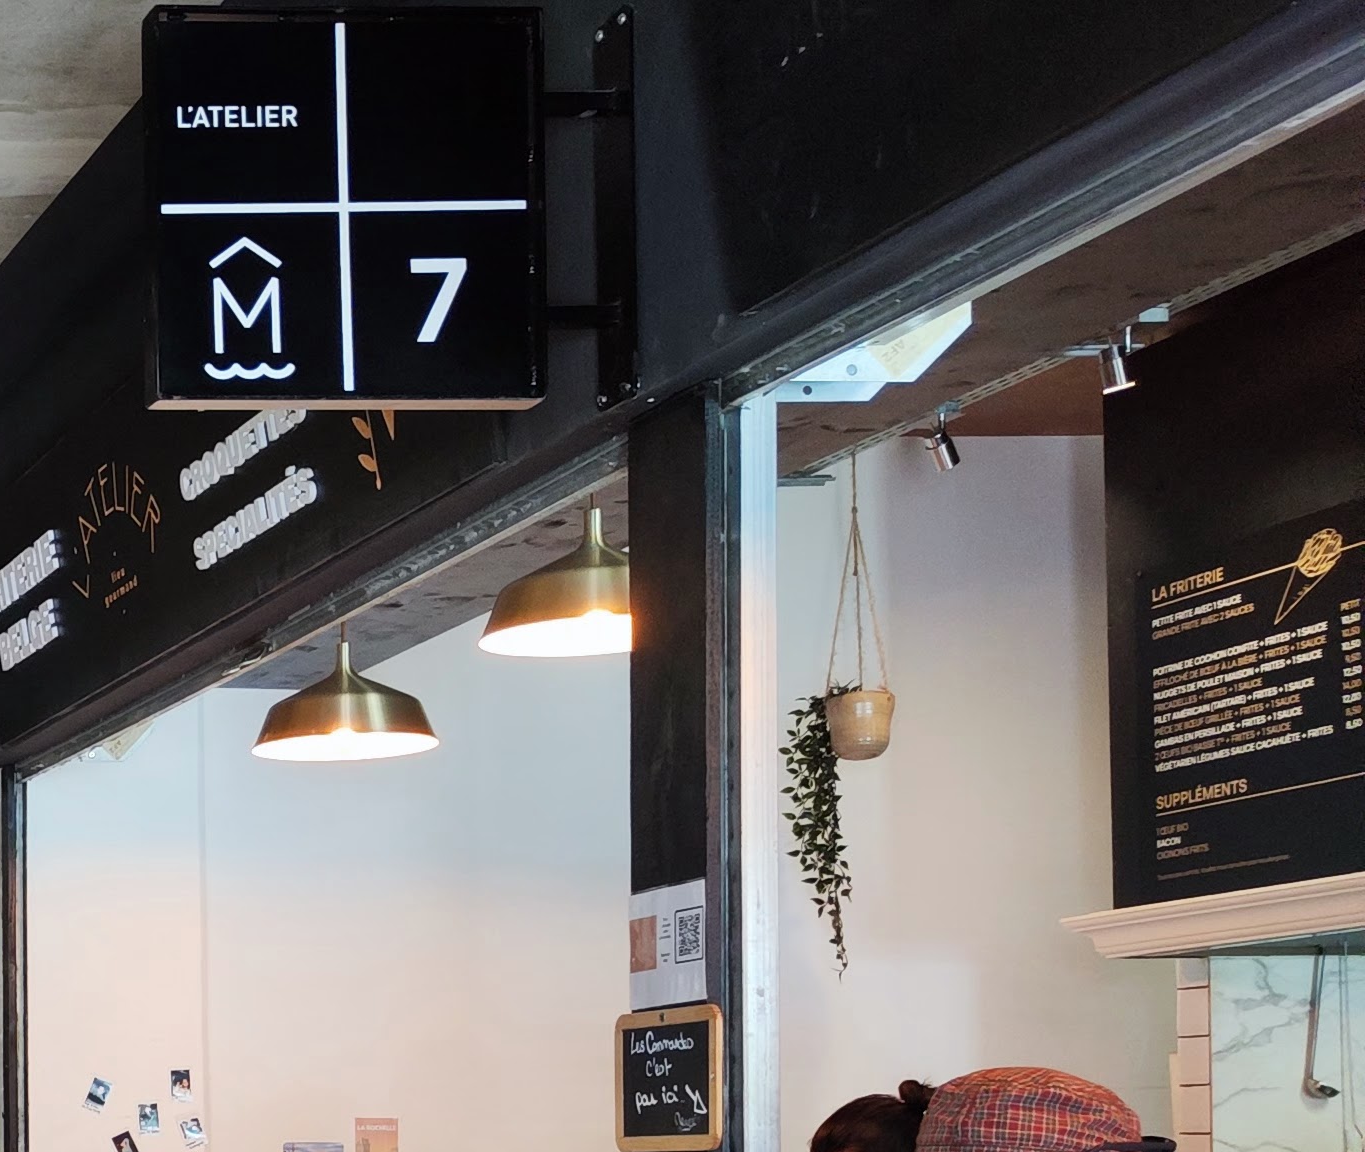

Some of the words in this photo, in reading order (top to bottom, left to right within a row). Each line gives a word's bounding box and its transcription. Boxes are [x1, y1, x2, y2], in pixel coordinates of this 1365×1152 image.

[177, 105, 298, 129] L'ATELIER
[410, 257, 468, 343] 7
[1152, 585, 1168, 603] LA
[1170, 566, 1225, 597] FRITERIE
[1156, 778, 1248, 810] SUPPLÉMENTS
